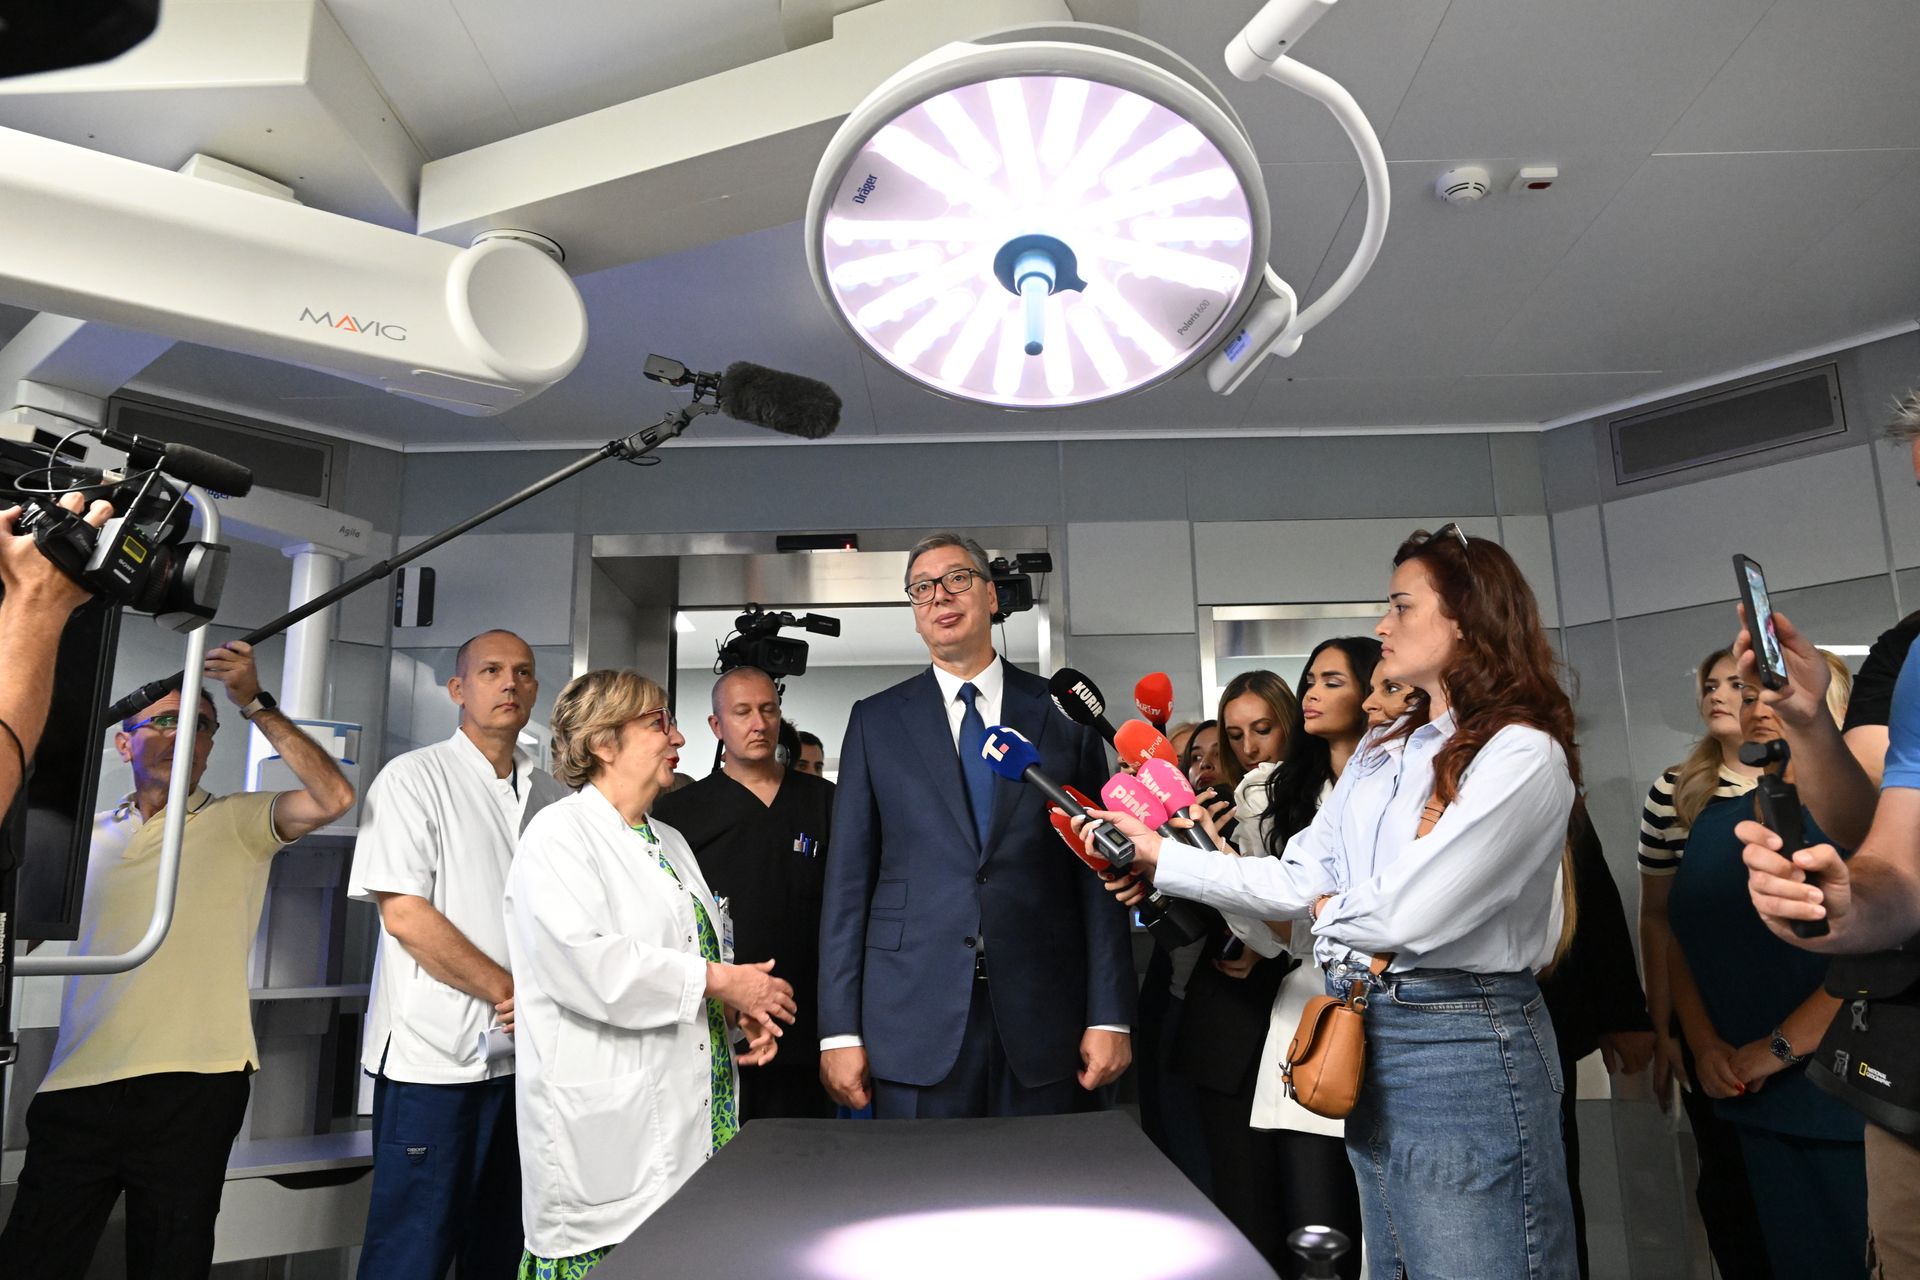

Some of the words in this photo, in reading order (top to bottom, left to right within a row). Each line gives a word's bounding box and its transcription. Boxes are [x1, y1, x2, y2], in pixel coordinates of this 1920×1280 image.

[852, 174, 877, 204] Dräger
[299, 307, 407, 341] MAVIG
[1177, 312, 1200, 336] Polaris
[1197, 299, 1210, 314] 600
[338, 525, 360, 538] Agila
[118, 559, 136, 574] SONY
[1071, 680, 1103, 718] KURIR
[1139, 767, 1171, 804] pink
[1109, 784, 1151, 823] pink
